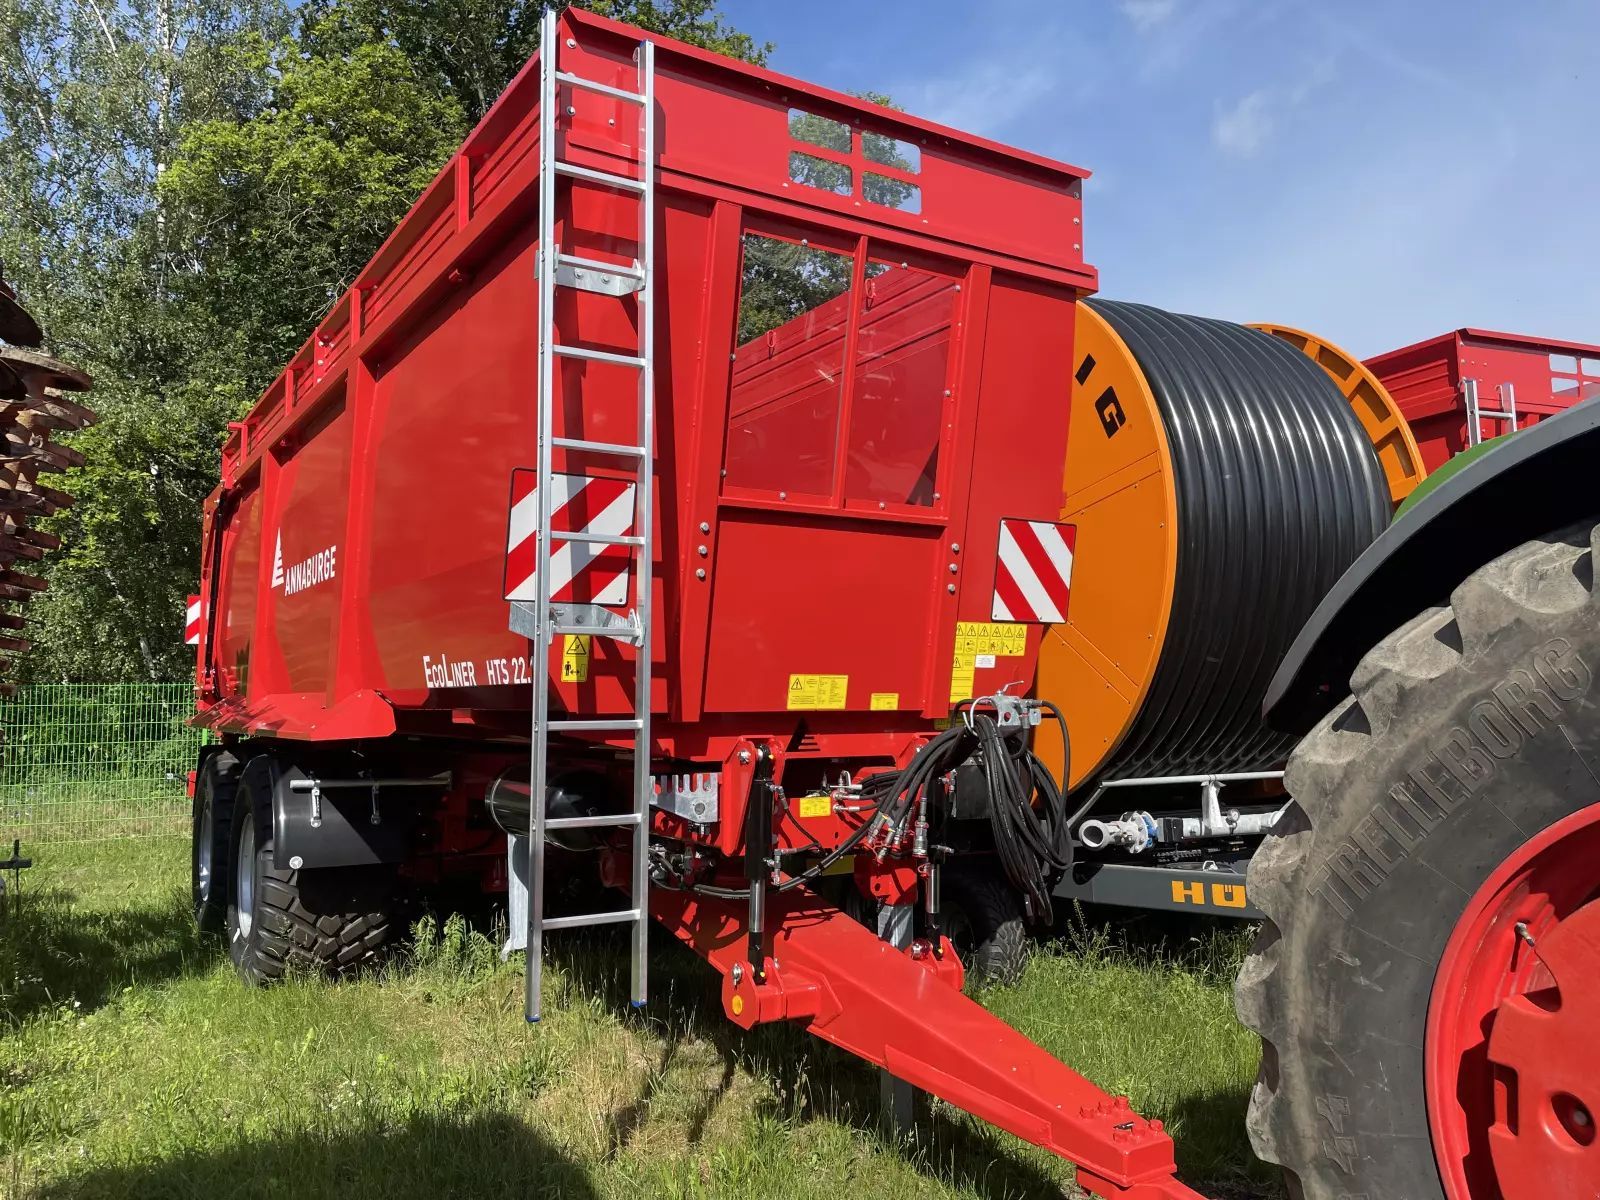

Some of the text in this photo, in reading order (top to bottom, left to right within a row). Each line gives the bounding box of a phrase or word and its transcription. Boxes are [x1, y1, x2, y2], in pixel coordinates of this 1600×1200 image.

[284, 545, 337, 597] ANNABURGE
[486, 658, 510, 685] HTS
[1306, 637, 1592, 920] TRELLEBORG
